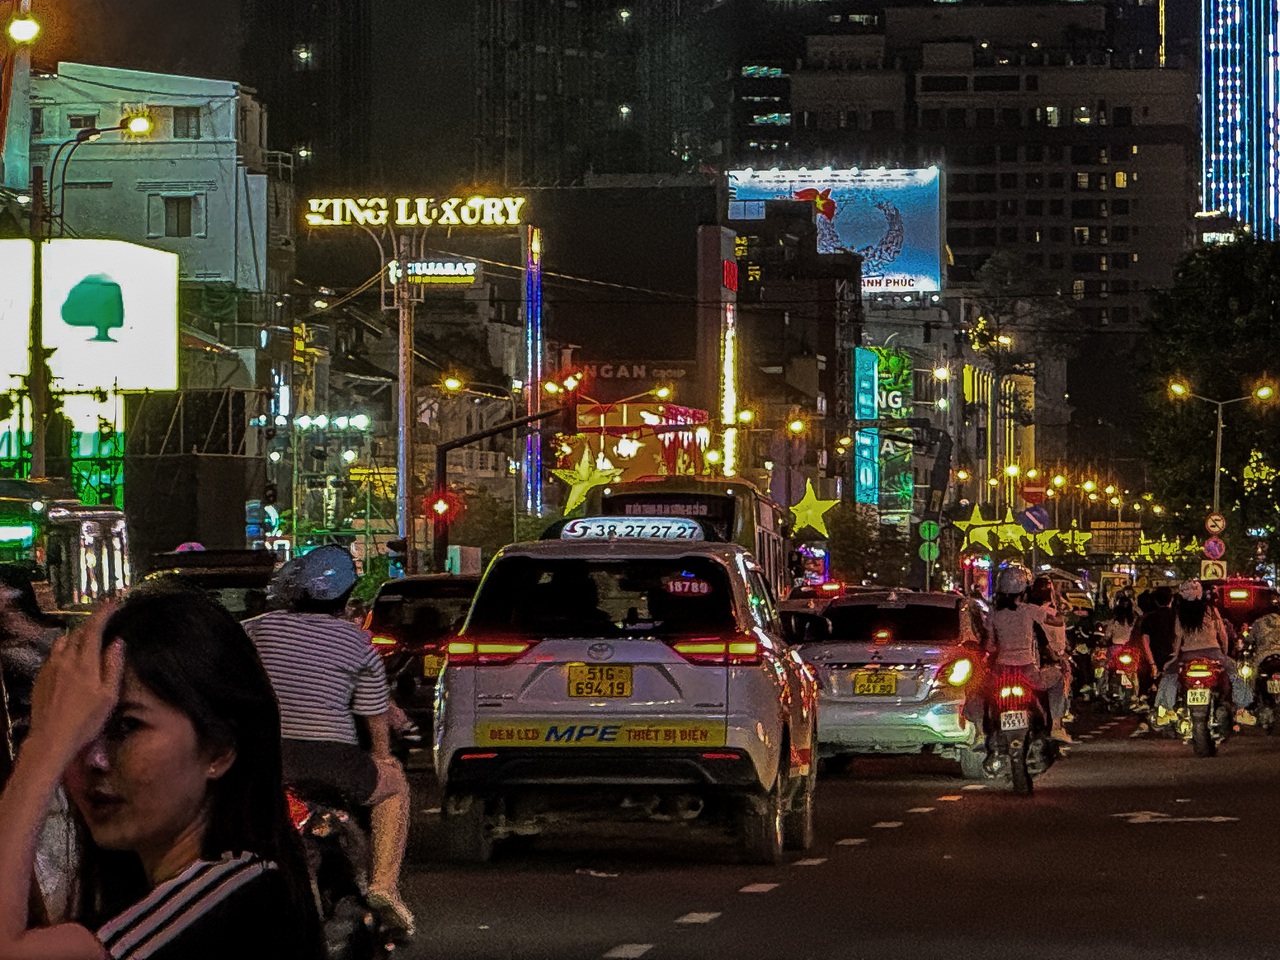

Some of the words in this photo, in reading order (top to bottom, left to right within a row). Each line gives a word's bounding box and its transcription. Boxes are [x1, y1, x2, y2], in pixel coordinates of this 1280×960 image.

[305, 197, 389, 226] KING
[395, 196, 526, 226] LUXURY
[885, 275, 915, 288] PHÚC
[587, 668, 614, 681] 51G
[575, 681, 625, 695] 694.19
[544, 725, 622, 743] MPE
